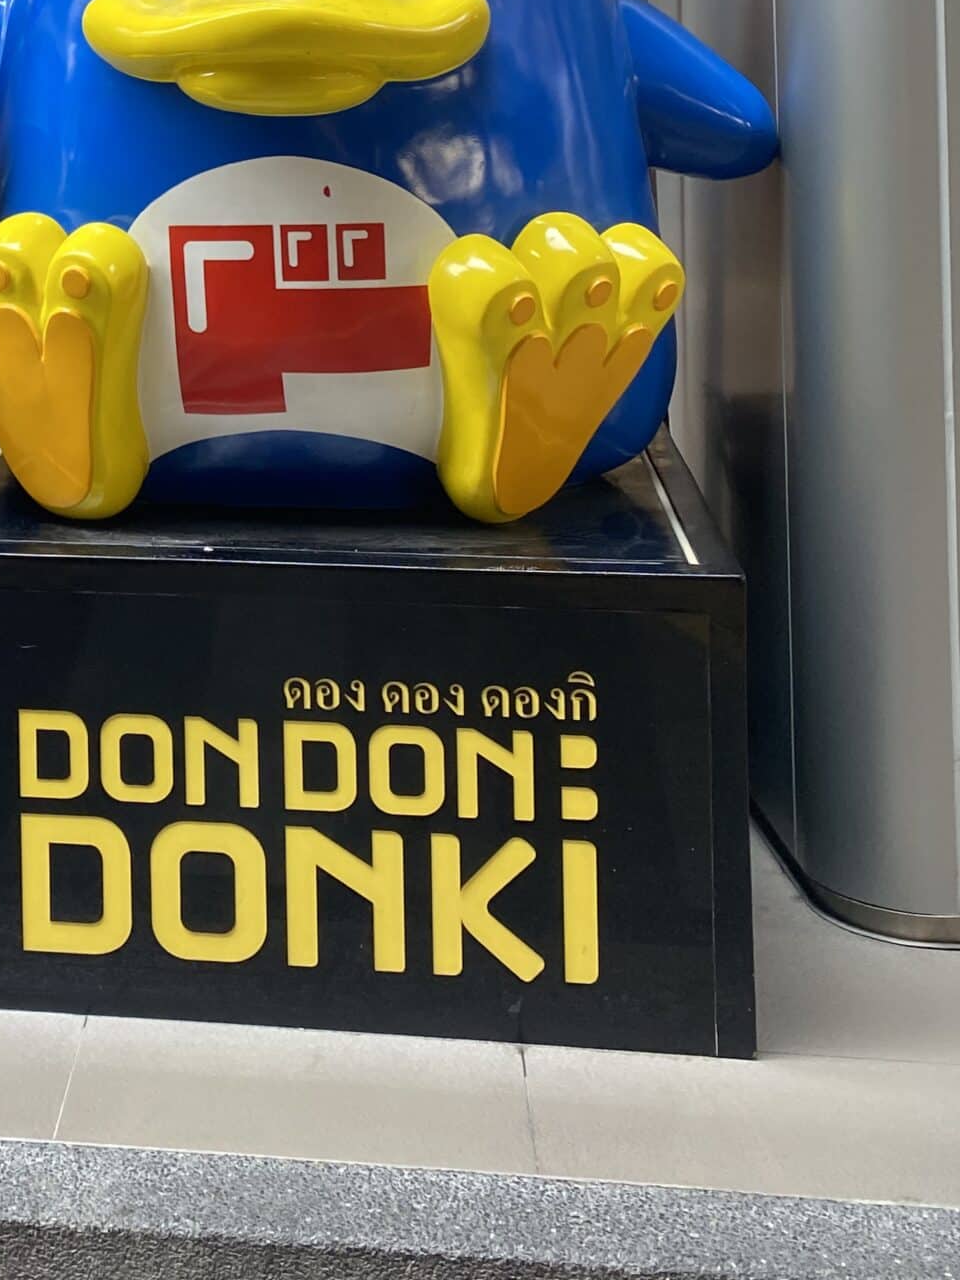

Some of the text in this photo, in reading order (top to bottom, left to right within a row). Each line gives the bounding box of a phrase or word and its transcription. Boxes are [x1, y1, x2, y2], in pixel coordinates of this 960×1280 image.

[283, 670, 598, 721] ดอง ดอง ดองกิ
[18, 708, 535, 822] DON DON
[21, 812, 600, 985] DONKI
